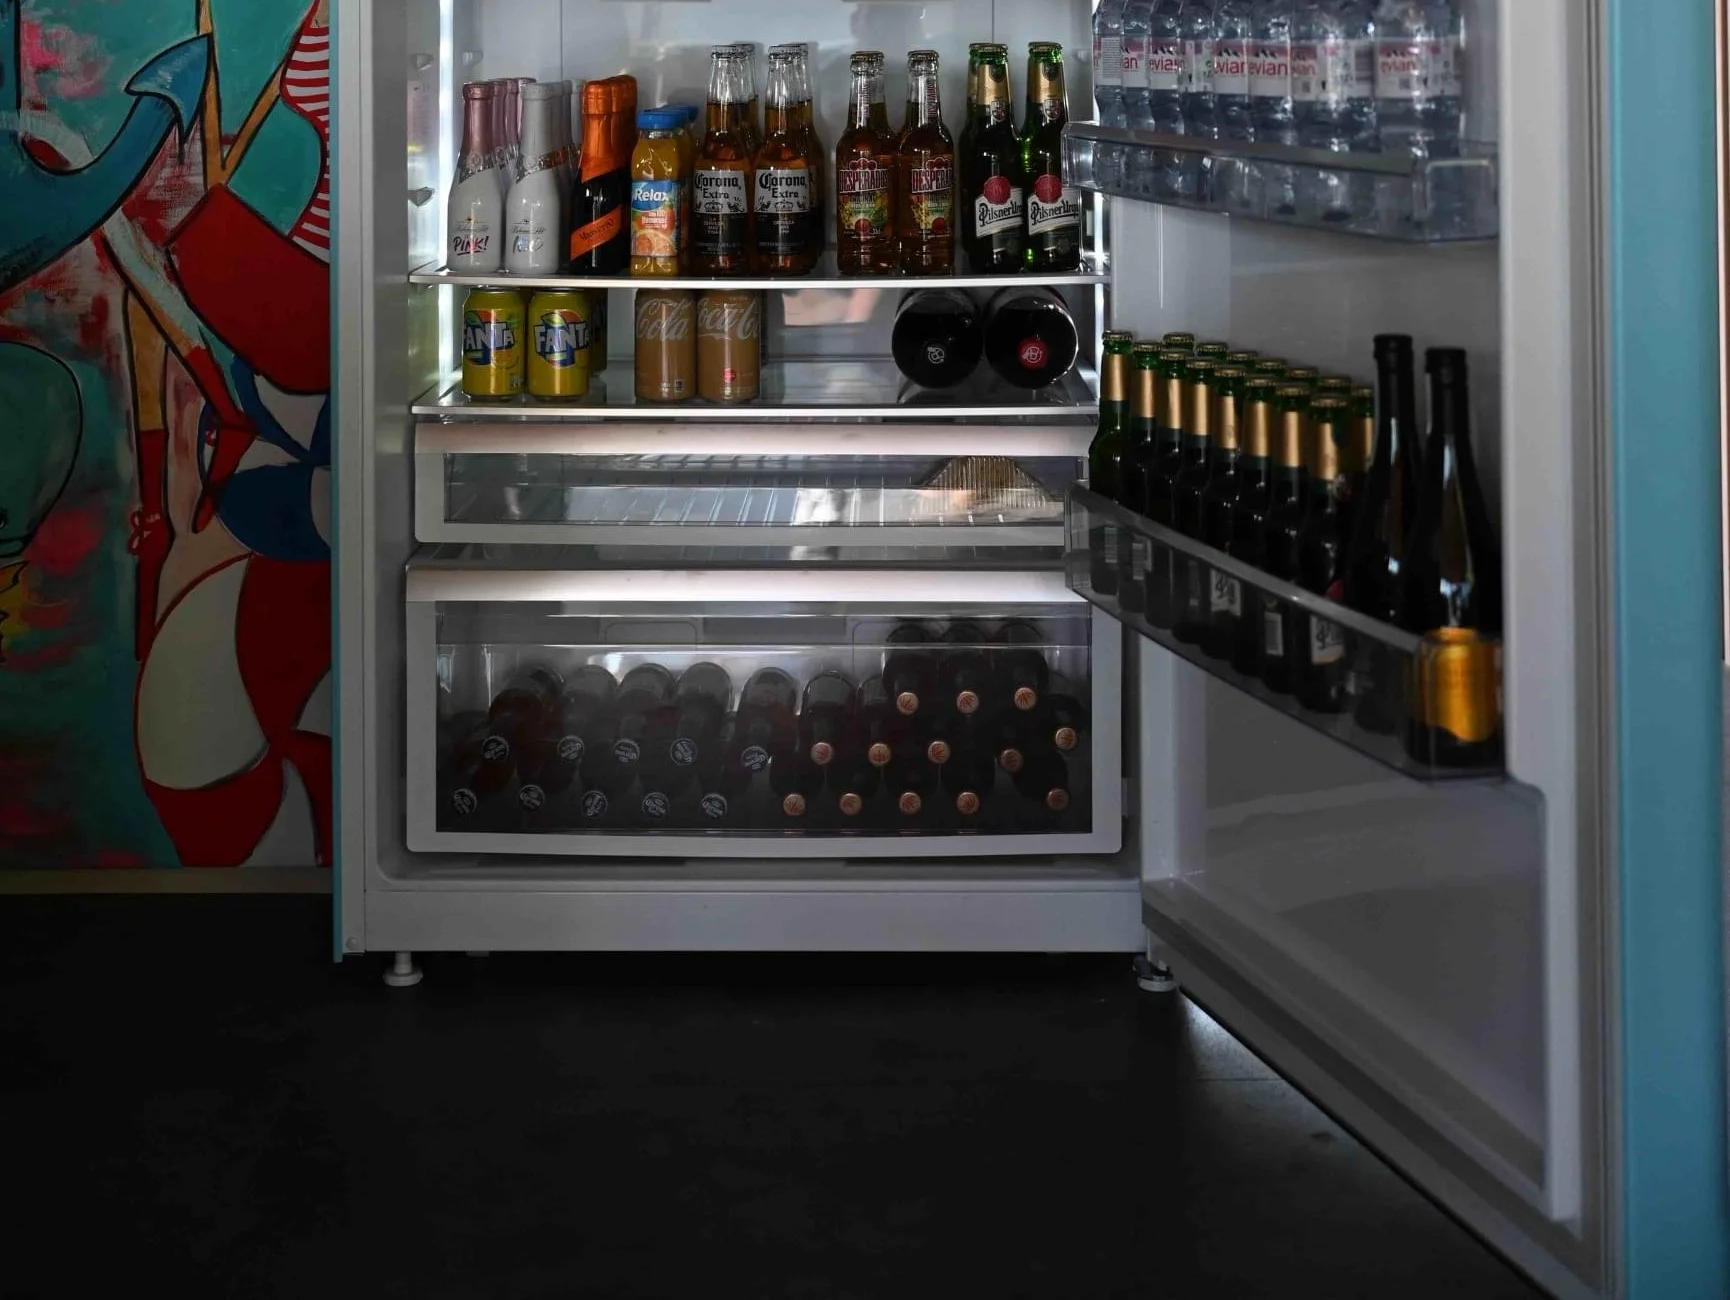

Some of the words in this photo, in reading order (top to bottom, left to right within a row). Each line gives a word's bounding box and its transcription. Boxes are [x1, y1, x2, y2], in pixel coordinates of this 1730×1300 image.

[1247, 60, 1288, 76] evian
[694, 172, 740, 190] Corona
[759, 172, 807, 190] Corona
[635, 187, 669, 202] Relax
[703, 188, 729, 199] Extra
[771, 188, 799, 199] Extra
[453, 235, 489, 253] PINK!
[464, 322, 515, 350] ANTA
